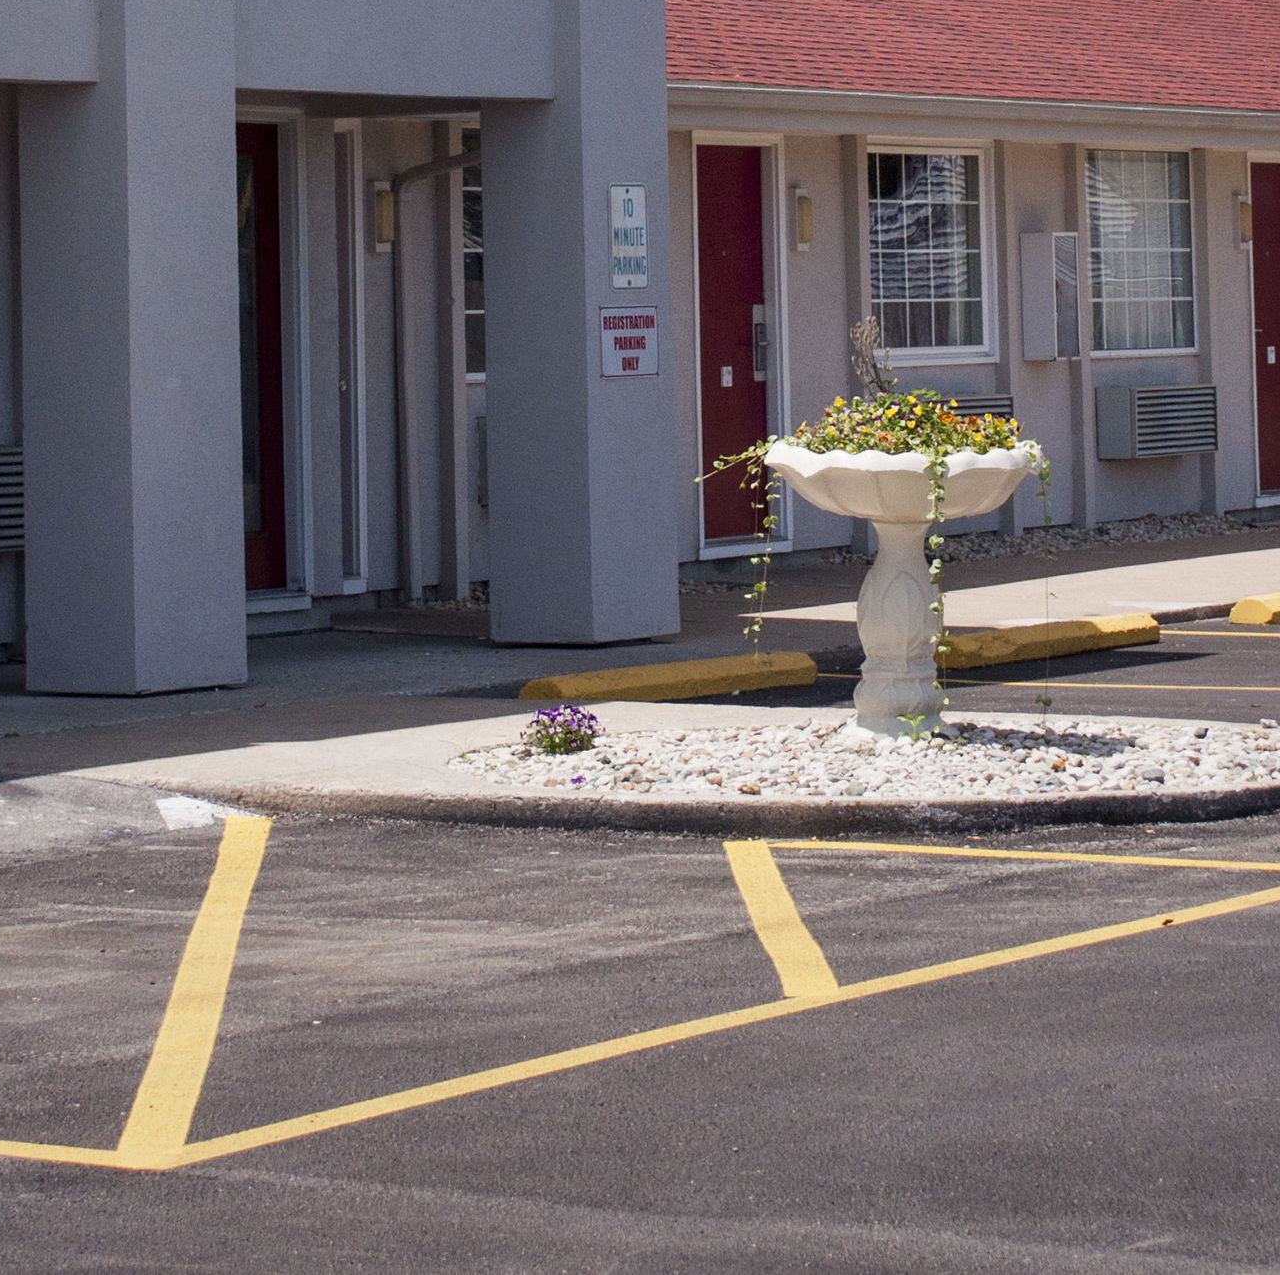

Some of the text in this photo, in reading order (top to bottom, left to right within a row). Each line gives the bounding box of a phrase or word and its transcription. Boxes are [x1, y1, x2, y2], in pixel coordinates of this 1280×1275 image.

[622, 197, 635, 218] 10
[613, 227, 645, 247] MINUTE
[613, 256, 647, 276] PARKING
[602, 315, 655, 330] REGISTRATION
[613, 336, 646, 351] PARKING
[621, 356, 640, 372] ONLY
